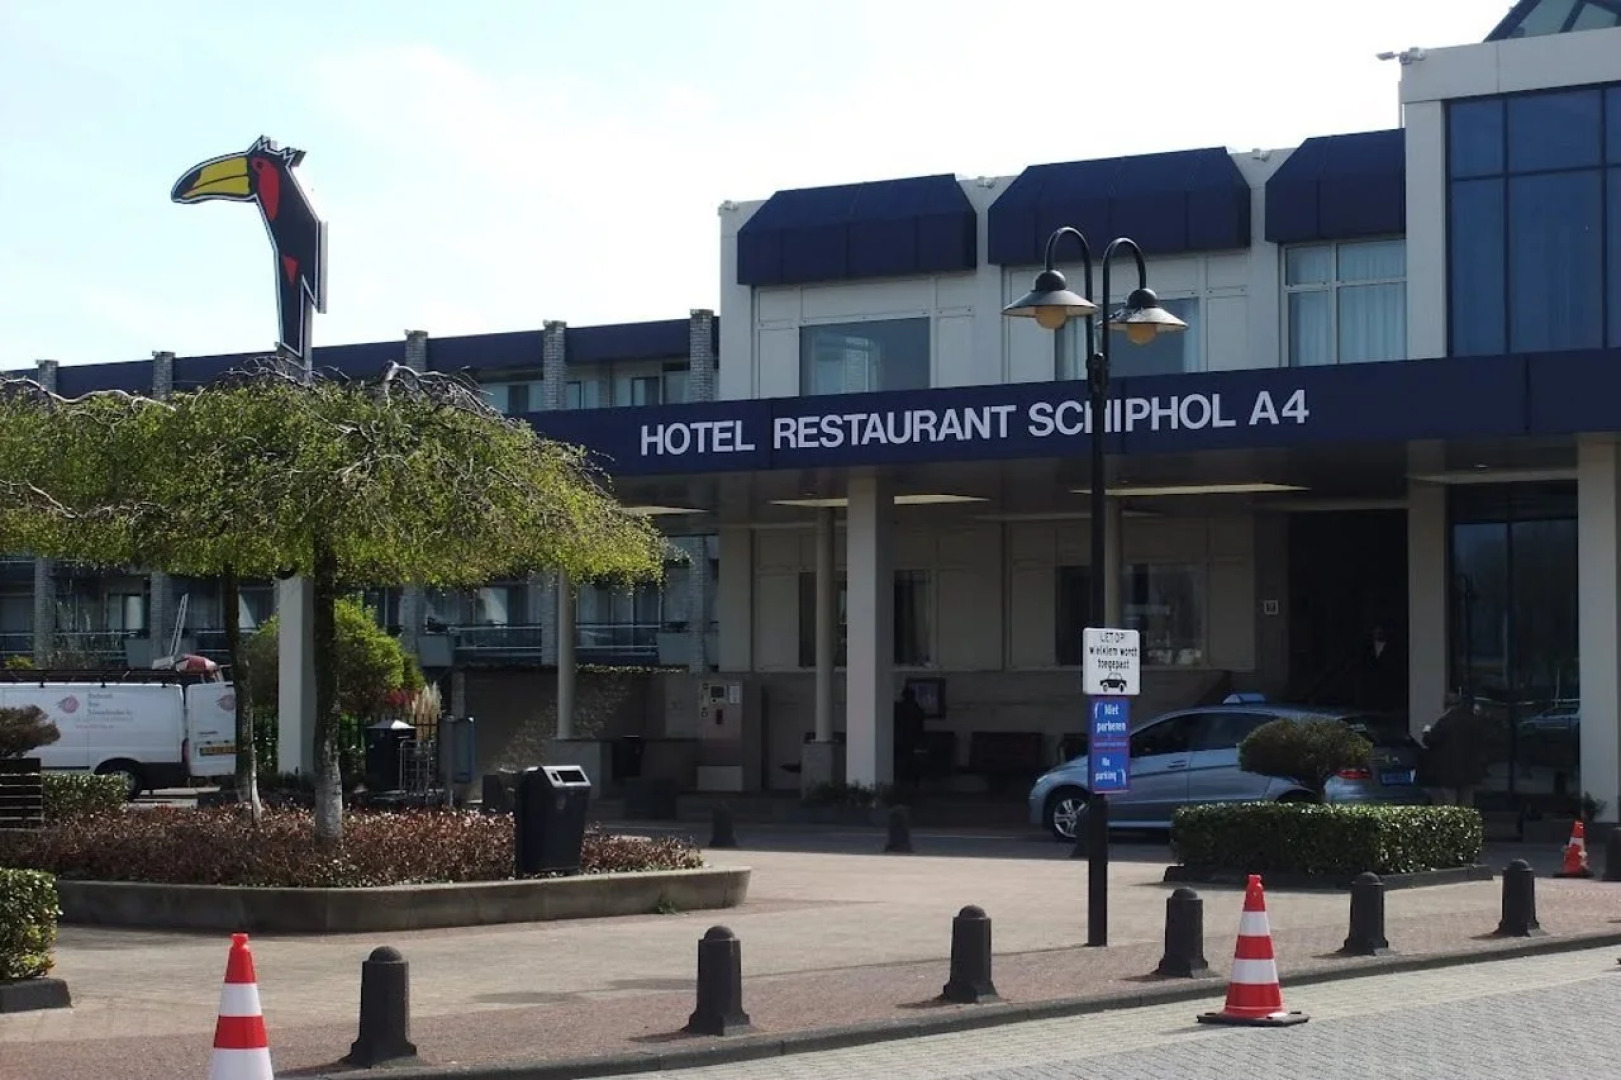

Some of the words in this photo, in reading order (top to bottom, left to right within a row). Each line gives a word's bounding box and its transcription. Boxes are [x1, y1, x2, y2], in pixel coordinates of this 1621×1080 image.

[641, 420, 756, 456] HOTEL
[774, 405, 1017, 449] RESTAURANT
[1028, 393, 1237, 437] SCHIPHOL
[1248, 389, 1310, 425] A4
[1104, 703, 1119, 715] Niet
[1097, 721, 1126, 734] parkeren
[1095, 771, 1117, 782] parking
